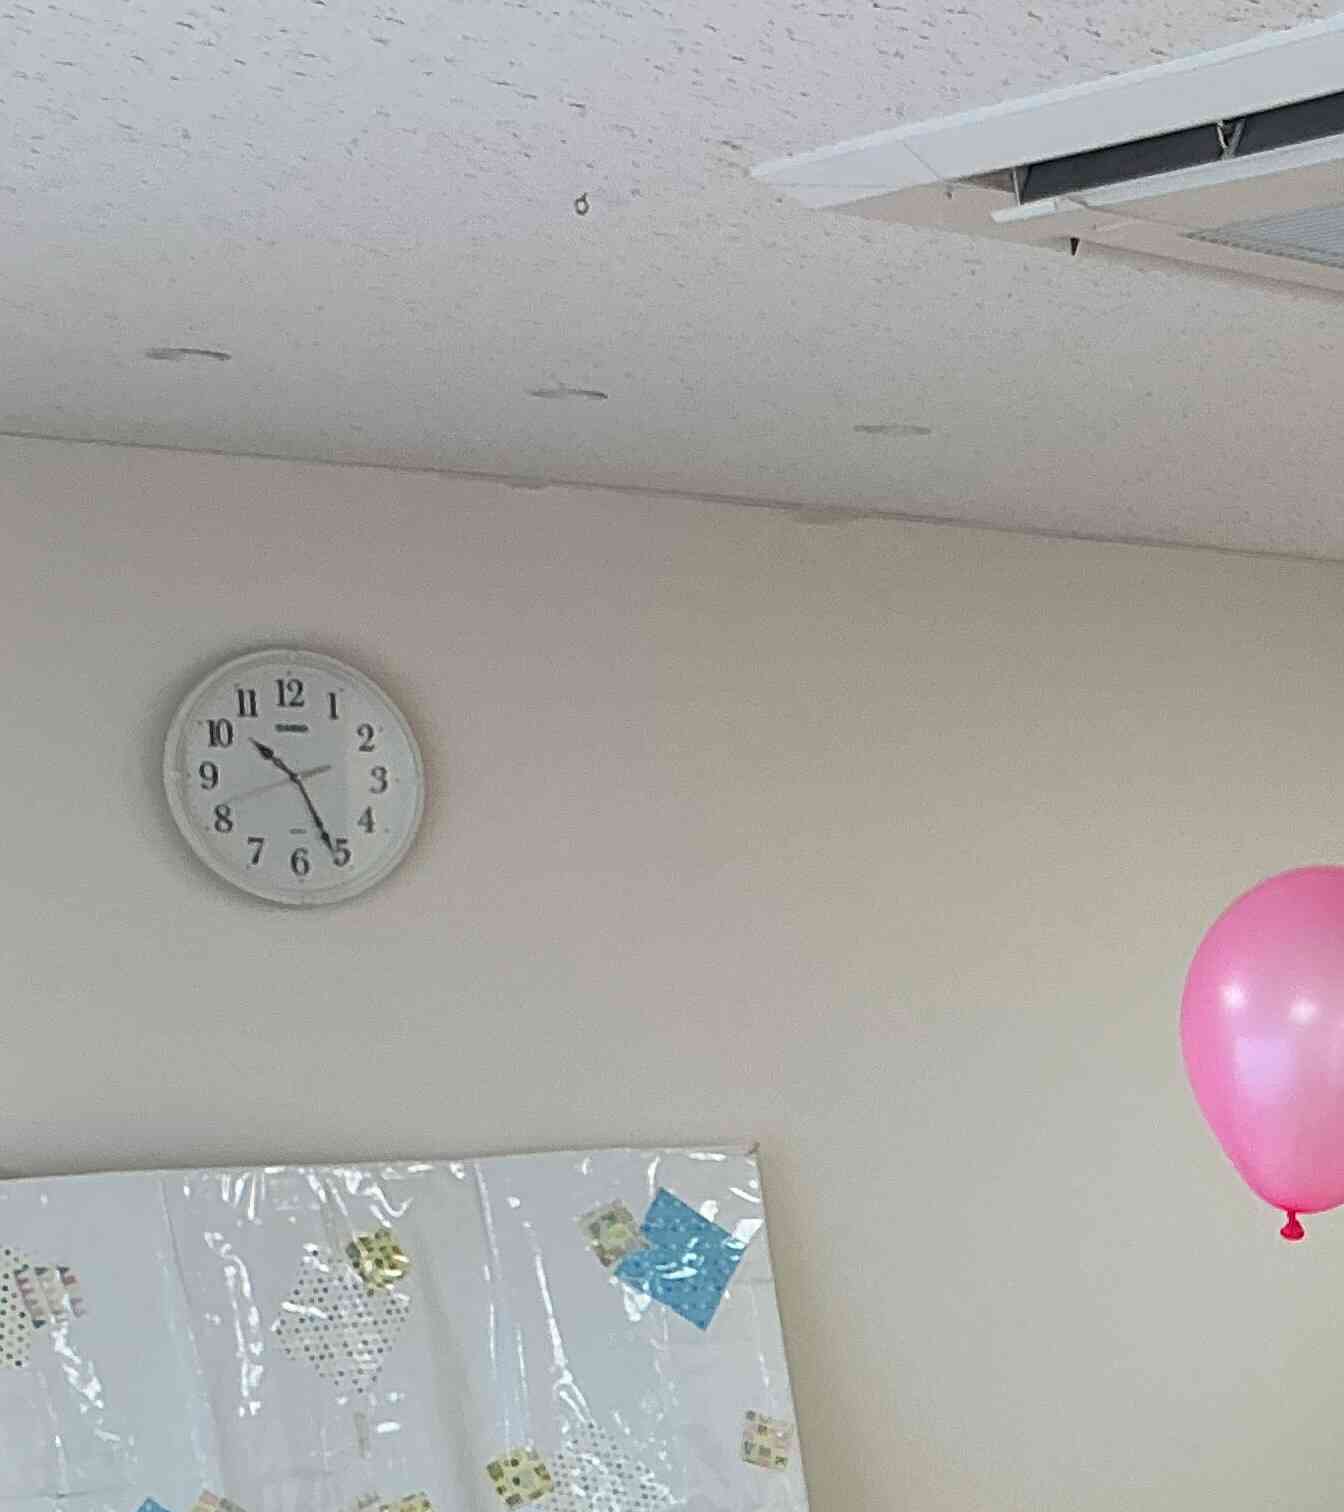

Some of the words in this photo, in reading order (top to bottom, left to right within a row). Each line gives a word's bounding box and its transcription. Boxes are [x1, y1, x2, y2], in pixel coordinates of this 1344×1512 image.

[237, 688, 258, 718] 11
[276, 678, 305, 707] 12
[328, 692, 339, 720] 1
[207, 718, 233, 748] 10
[357, 723, 375, 752] 2
[199, 761, 219, 790] 9
[369, 766, 388, 794] 3
[214, 803, 234, 833] 8
[357, 806, 375, 833] 4
[248, 837, 264, 865] 7
[290, 848, 310, 876] 6
[333, 838, 351, 867] 5
